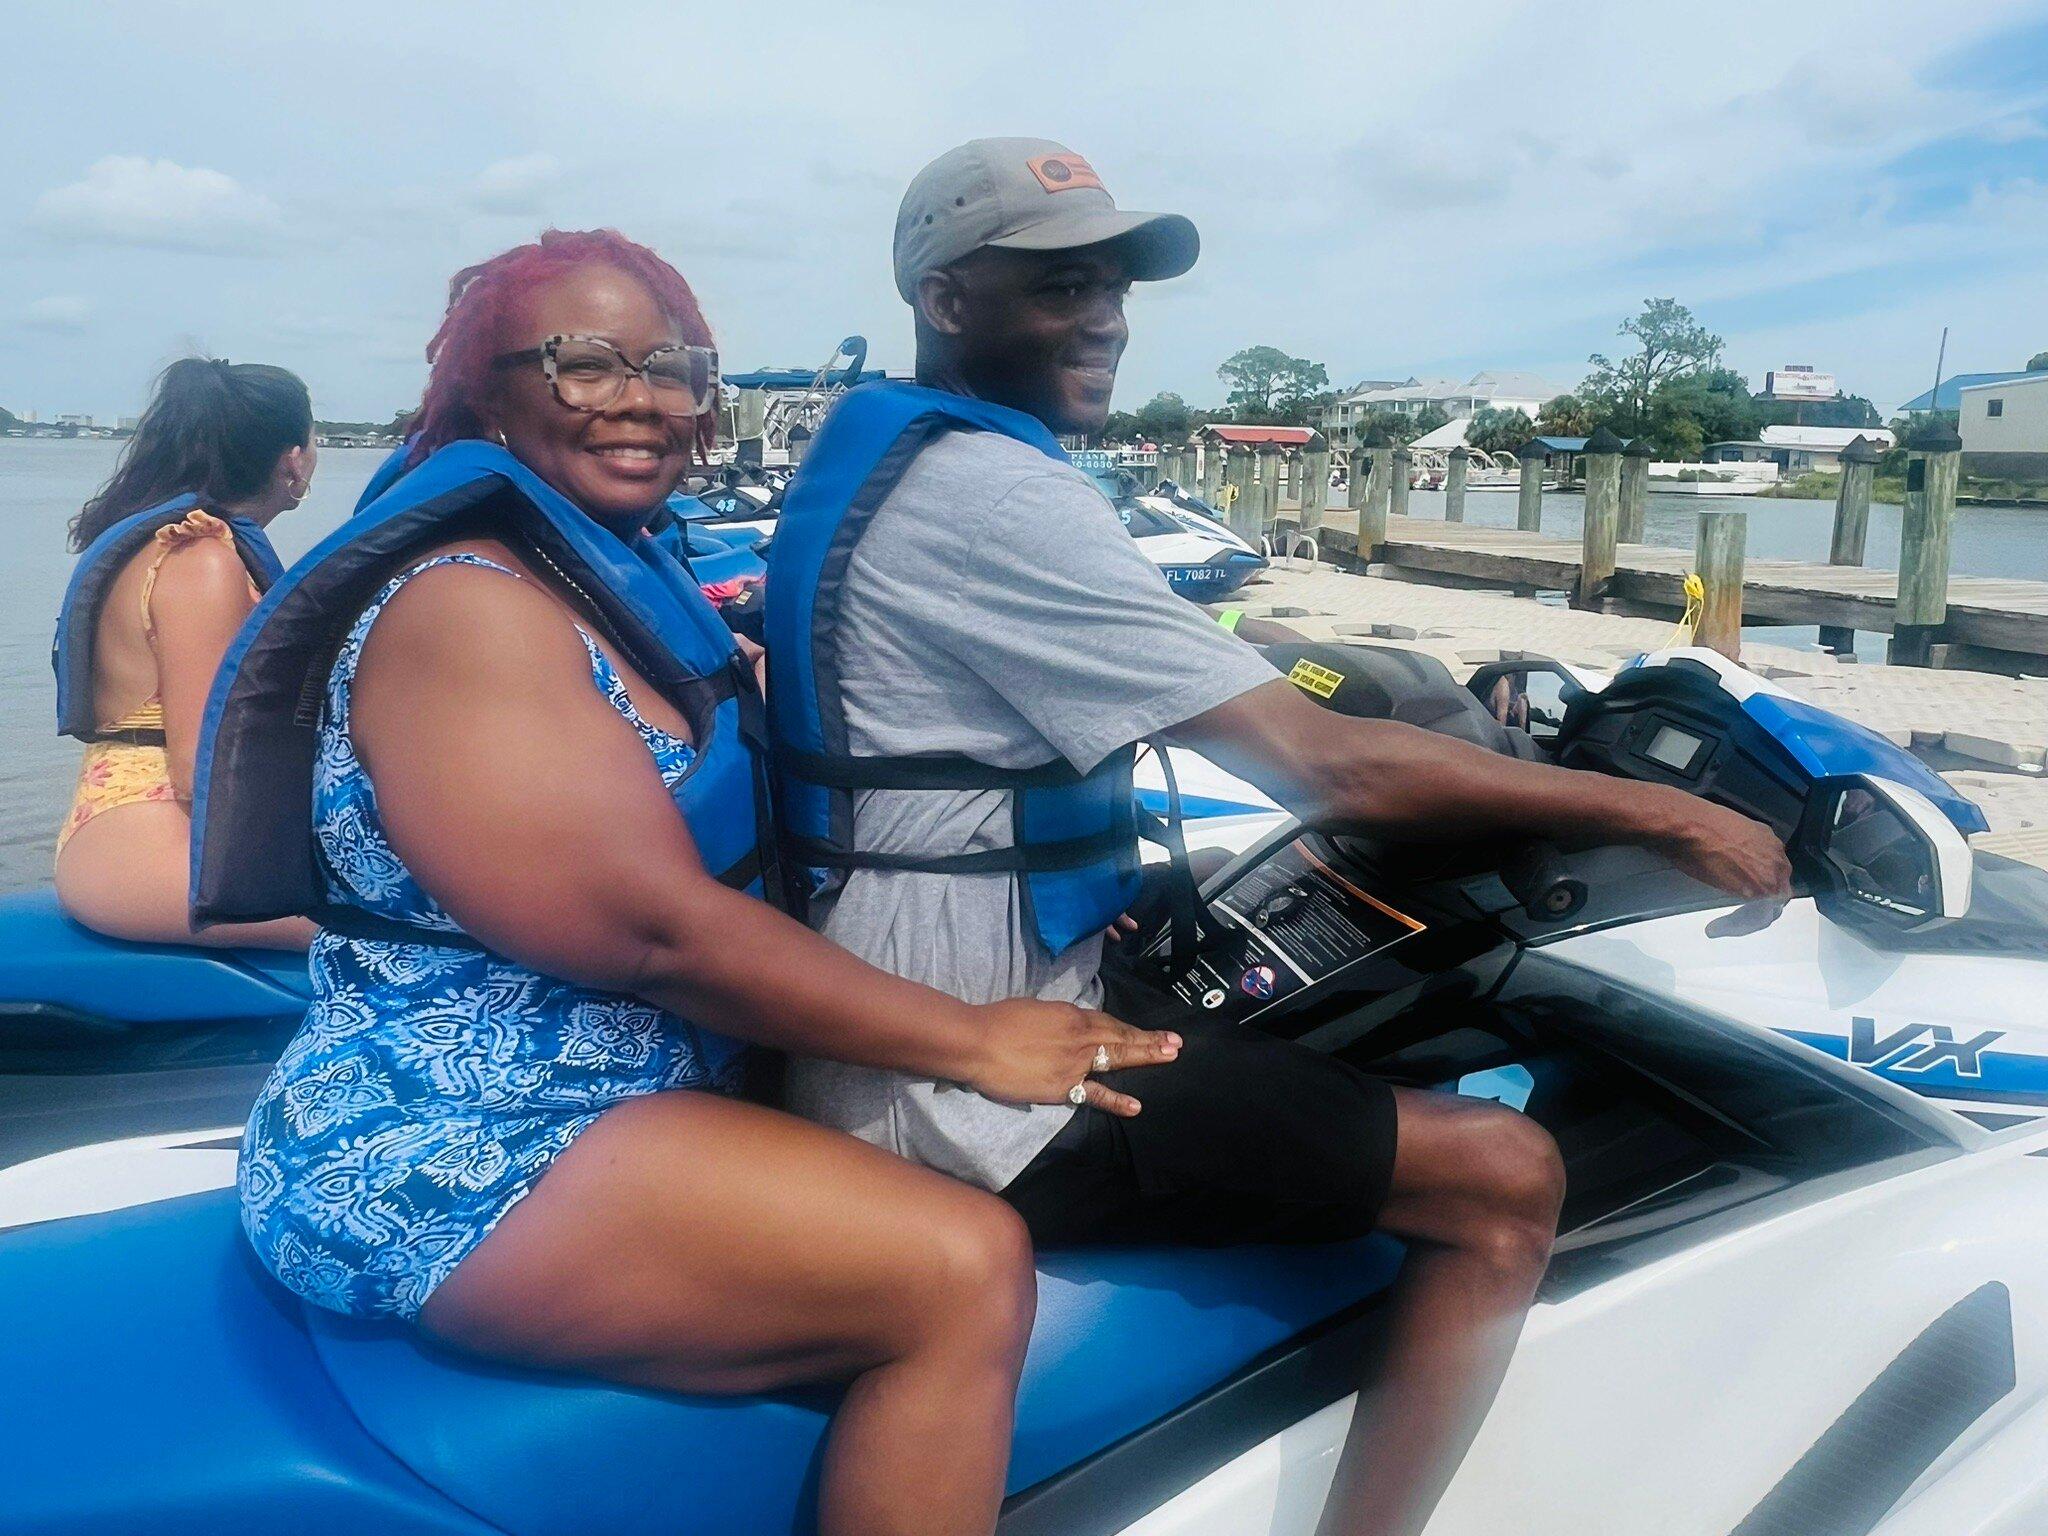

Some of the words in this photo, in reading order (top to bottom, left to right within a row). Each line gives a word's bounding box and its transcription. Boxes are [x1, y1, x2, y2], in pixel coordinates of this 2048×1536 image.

[1166, 570, 1182, 581] FL
[1185, 569, 1211, 580] 7082
[1849, 1016, 2007, 1077] VX
